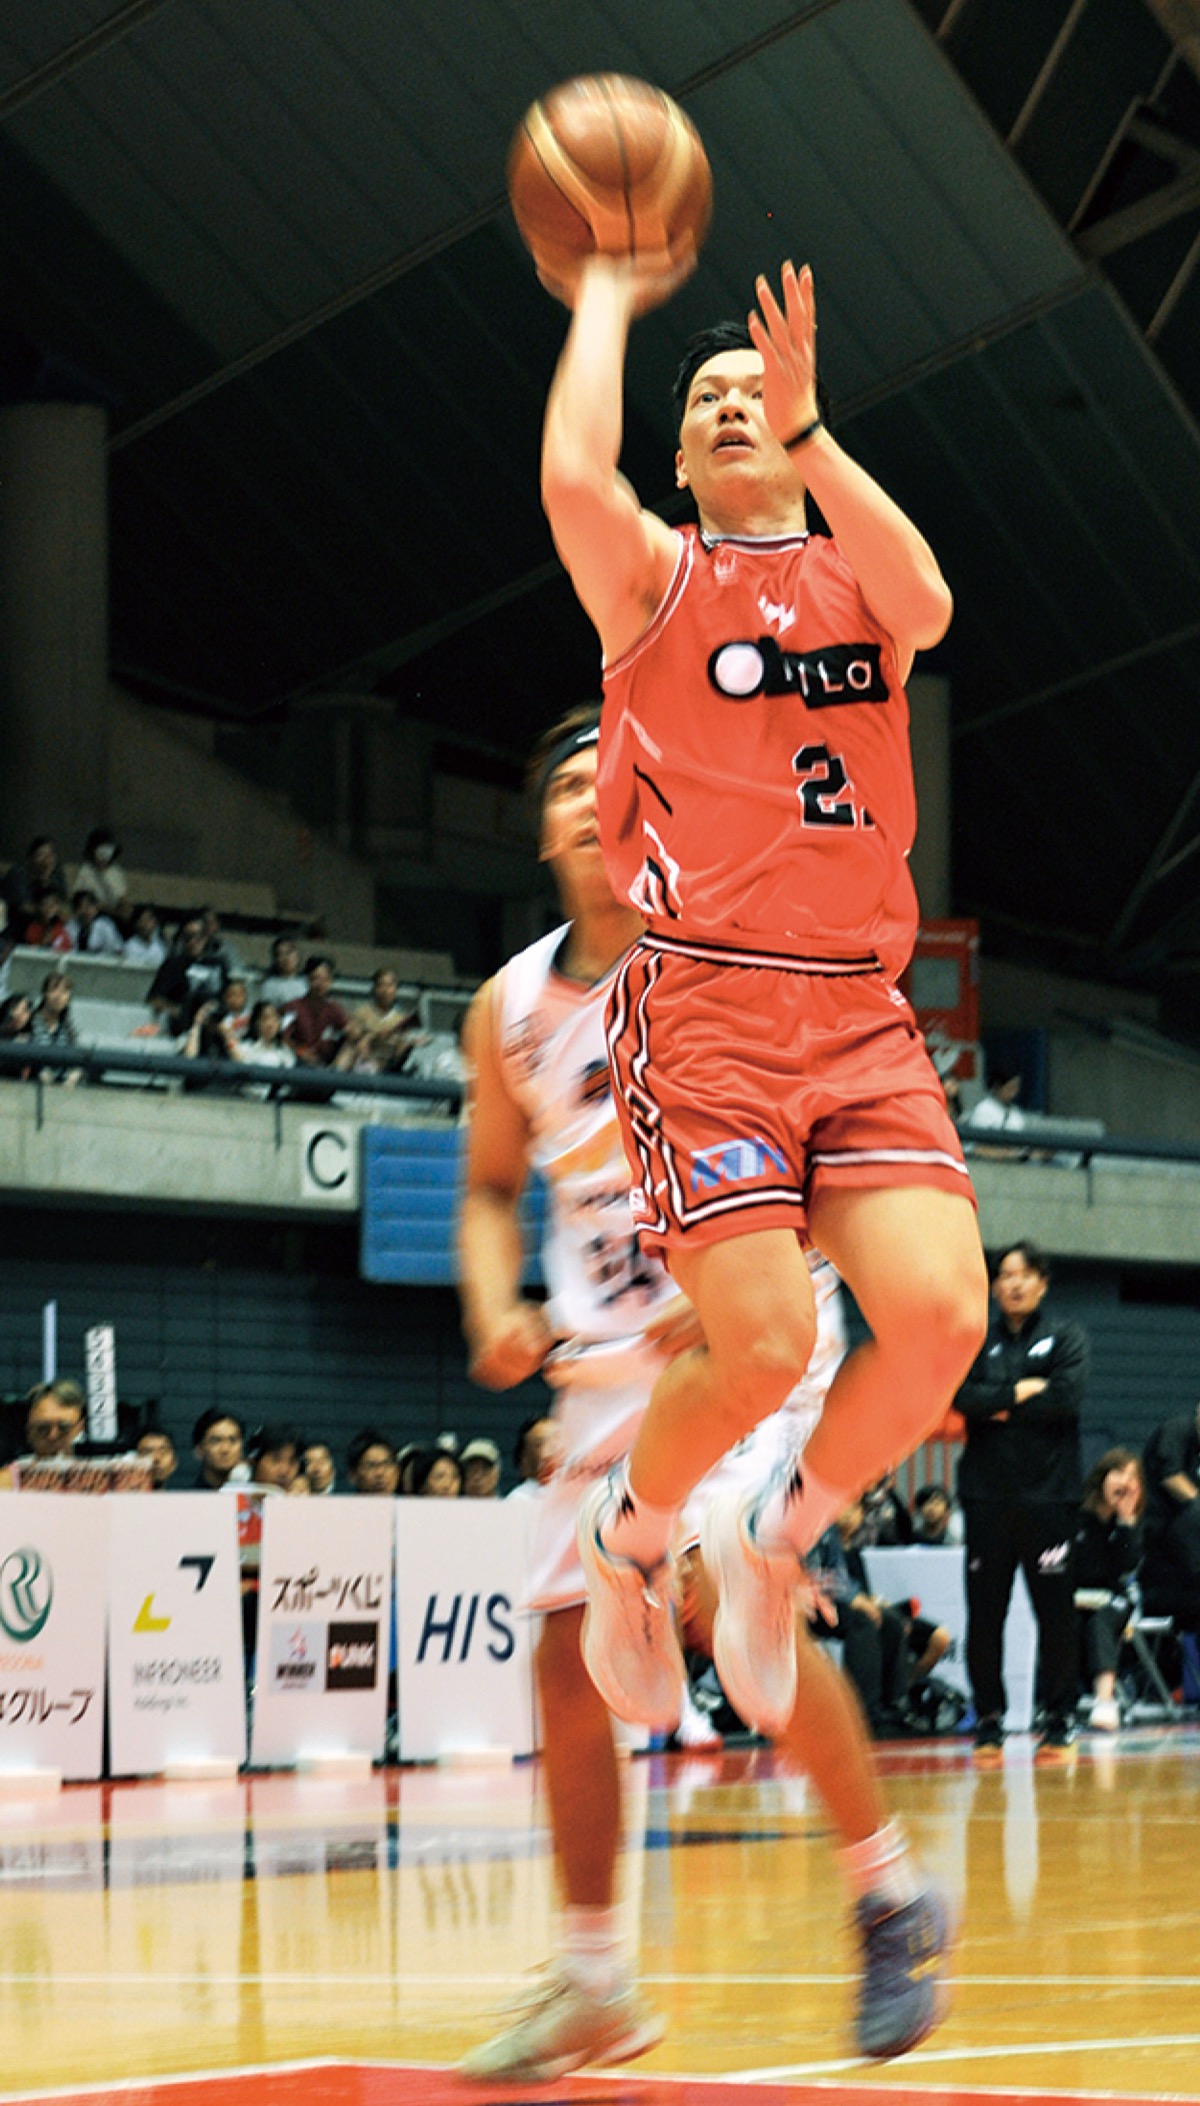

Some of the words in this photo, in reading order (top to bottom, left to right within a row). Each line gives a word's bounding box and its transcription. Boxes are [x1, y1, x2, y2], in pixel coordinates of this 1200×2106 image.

[792, 741, 876, 830] 2
[306, 1129, 348, 1191] C
[271, 1566, 384, 1612] スポーツくじ
[415, 1592, 515, 1664] HIS
